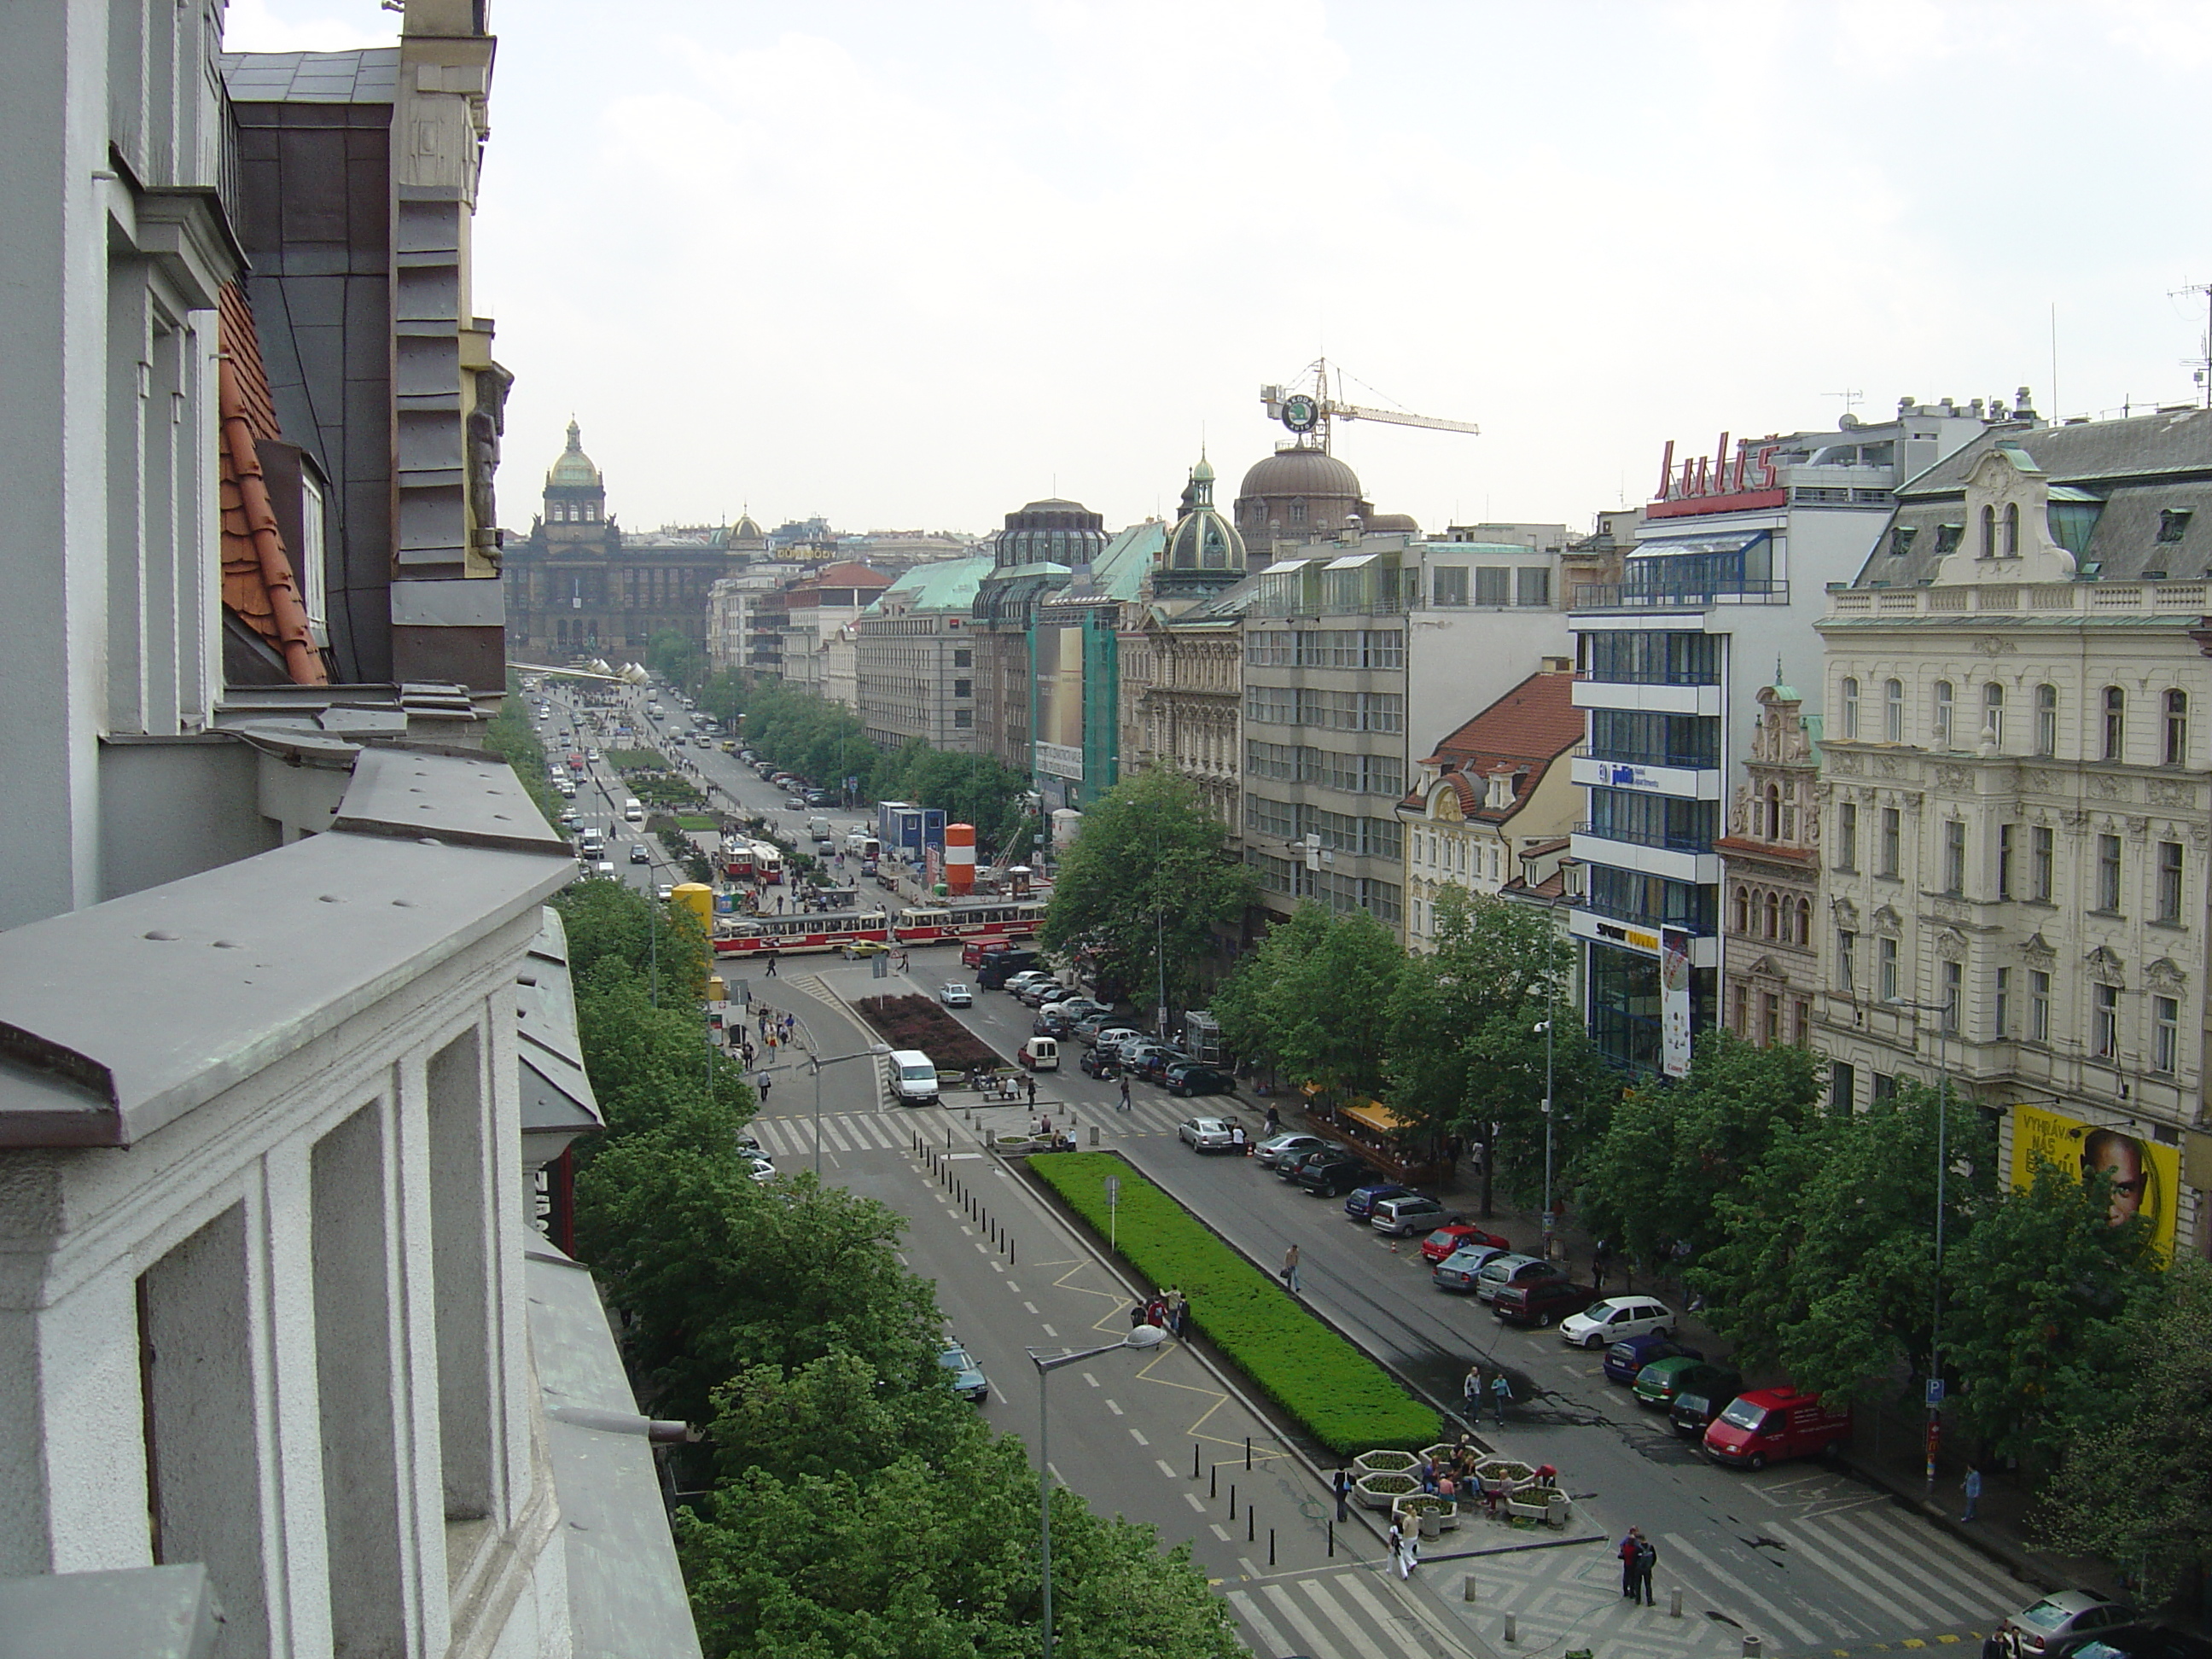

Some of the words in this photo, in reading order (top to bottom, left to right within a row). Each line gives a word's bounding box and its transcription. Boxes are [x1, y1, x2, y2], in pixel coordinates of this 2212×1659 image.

[1654, 431, 1780, 500] Juliš
[2023, 1114, 2077, 1144] VYHRÁVA
[1930, 1381, 1940, 1394] P
